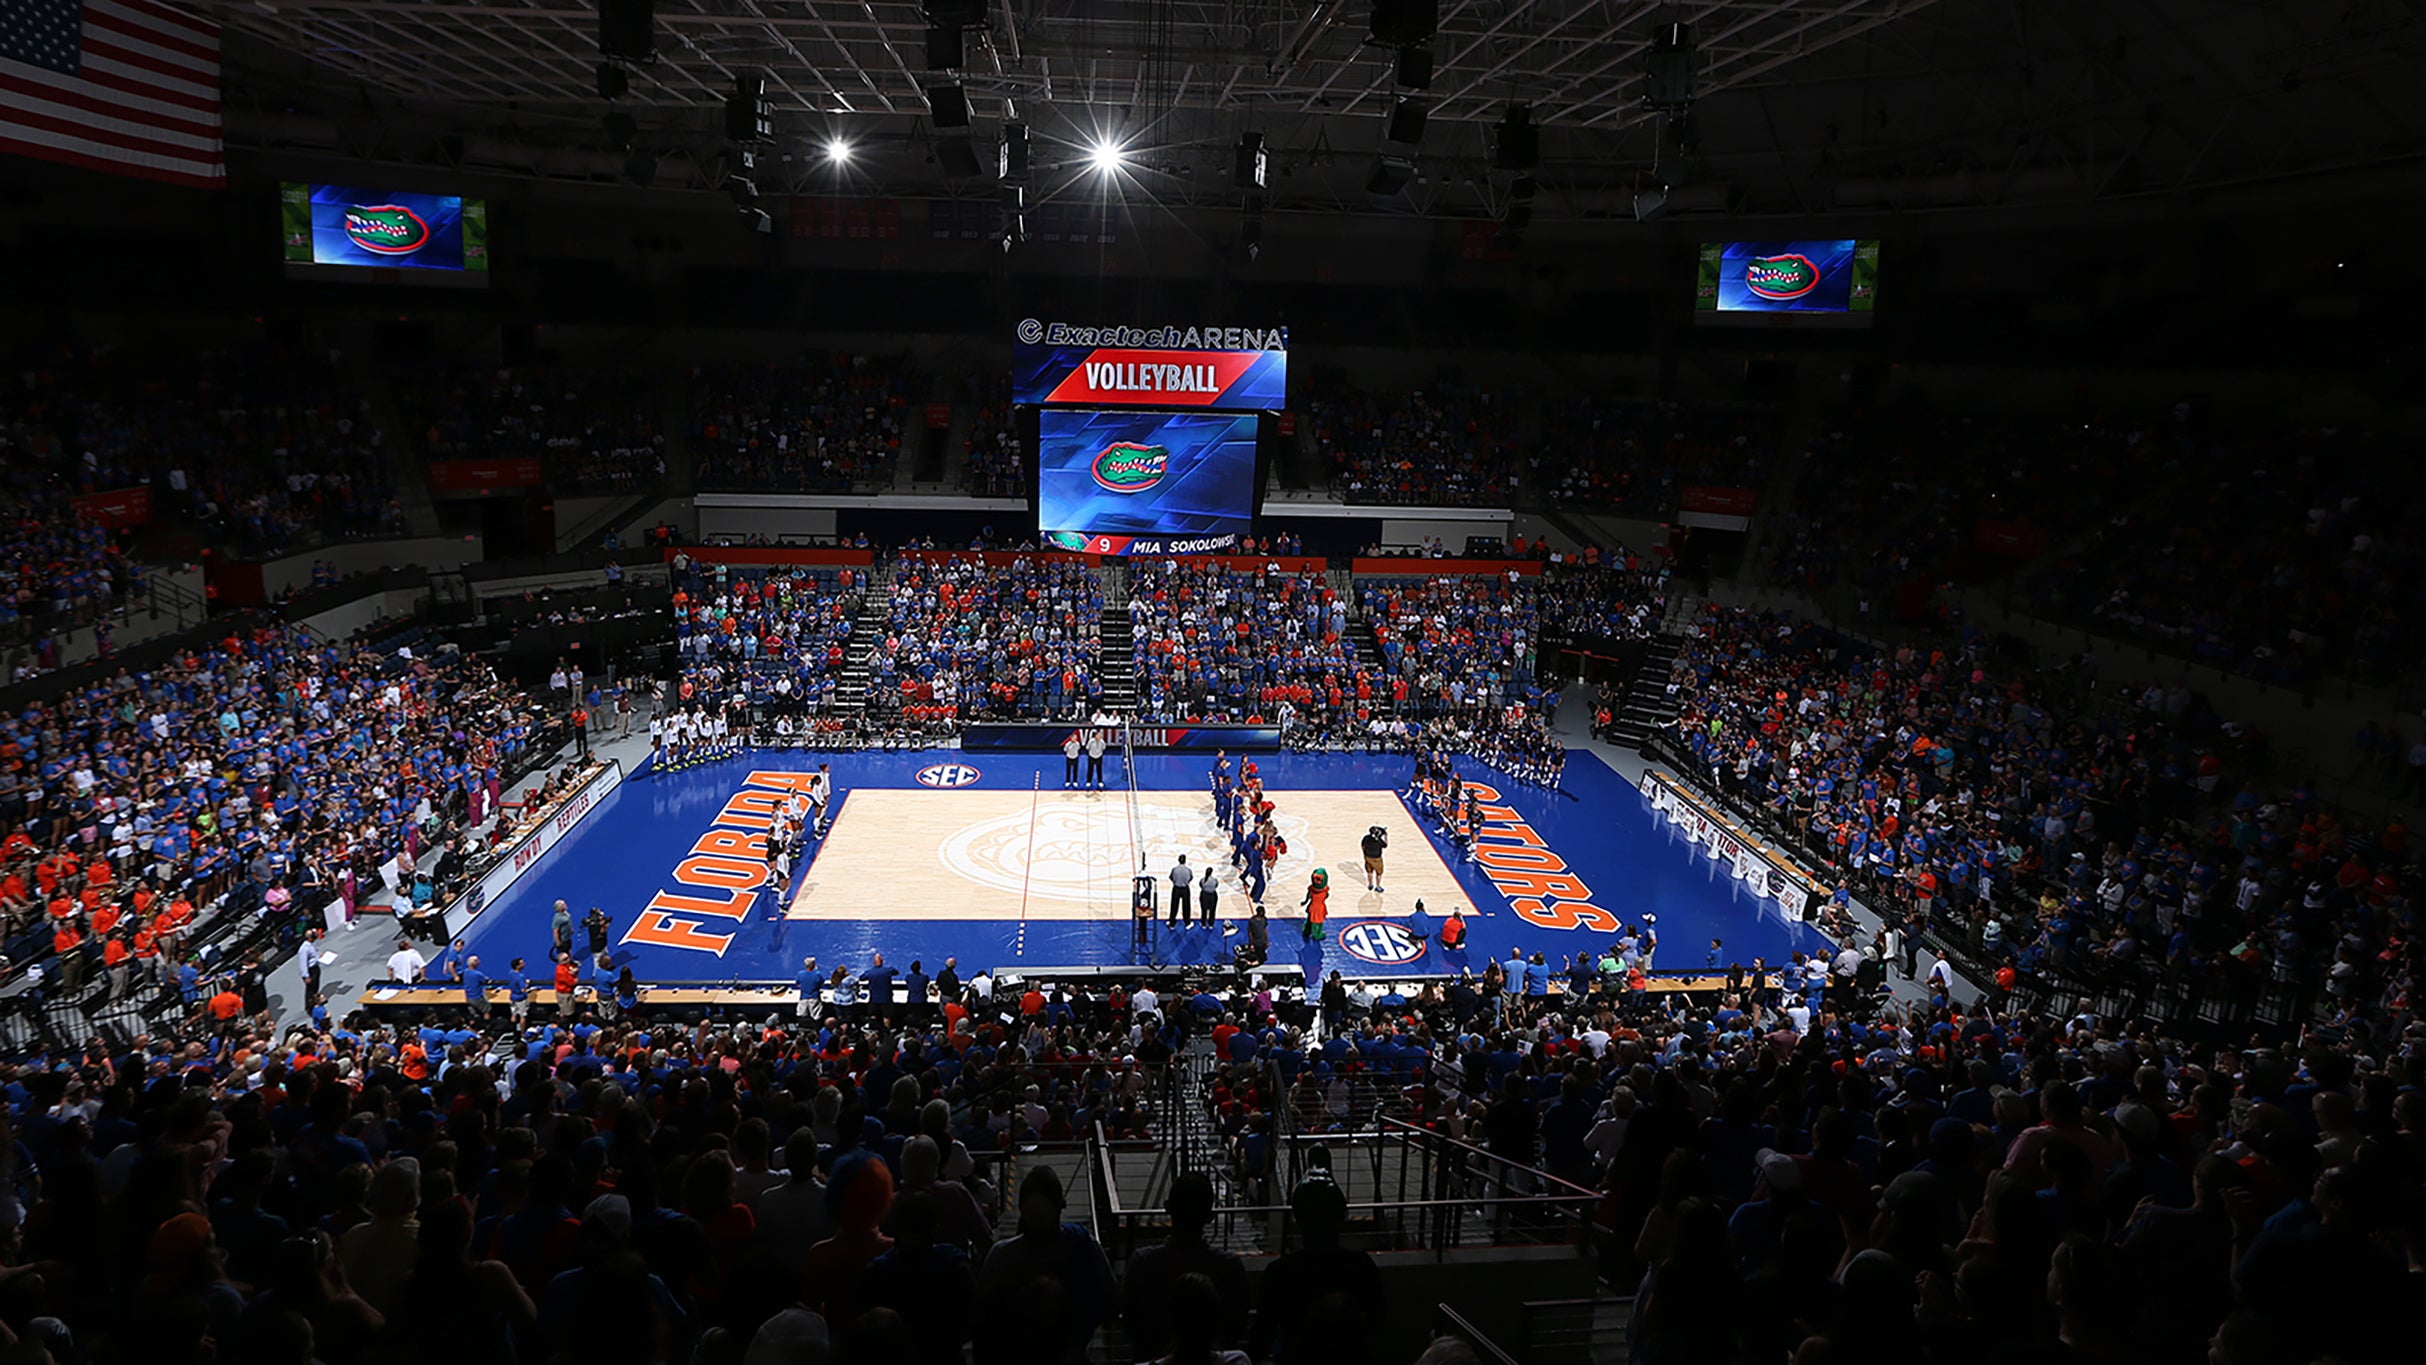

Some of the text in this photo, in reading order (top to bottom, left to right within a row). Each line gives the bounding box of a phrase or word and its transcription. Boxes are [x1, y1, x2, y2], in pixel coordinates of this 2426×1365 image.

[1045, 323, 1284, 350] Exactech ARENA
[1085, 362, 1219, 393] VOLLEYBALL
[1100, 538, 1110, 552] 9
[1132, 542, 1161, 554] MIA
[920, 765, 978, 786] SEC
[514, 793, 589, 872] ROWDY REPTILES
[618, 771, 823, 958] FLORIDA
[1345, 924, 1418, 961] SEC
